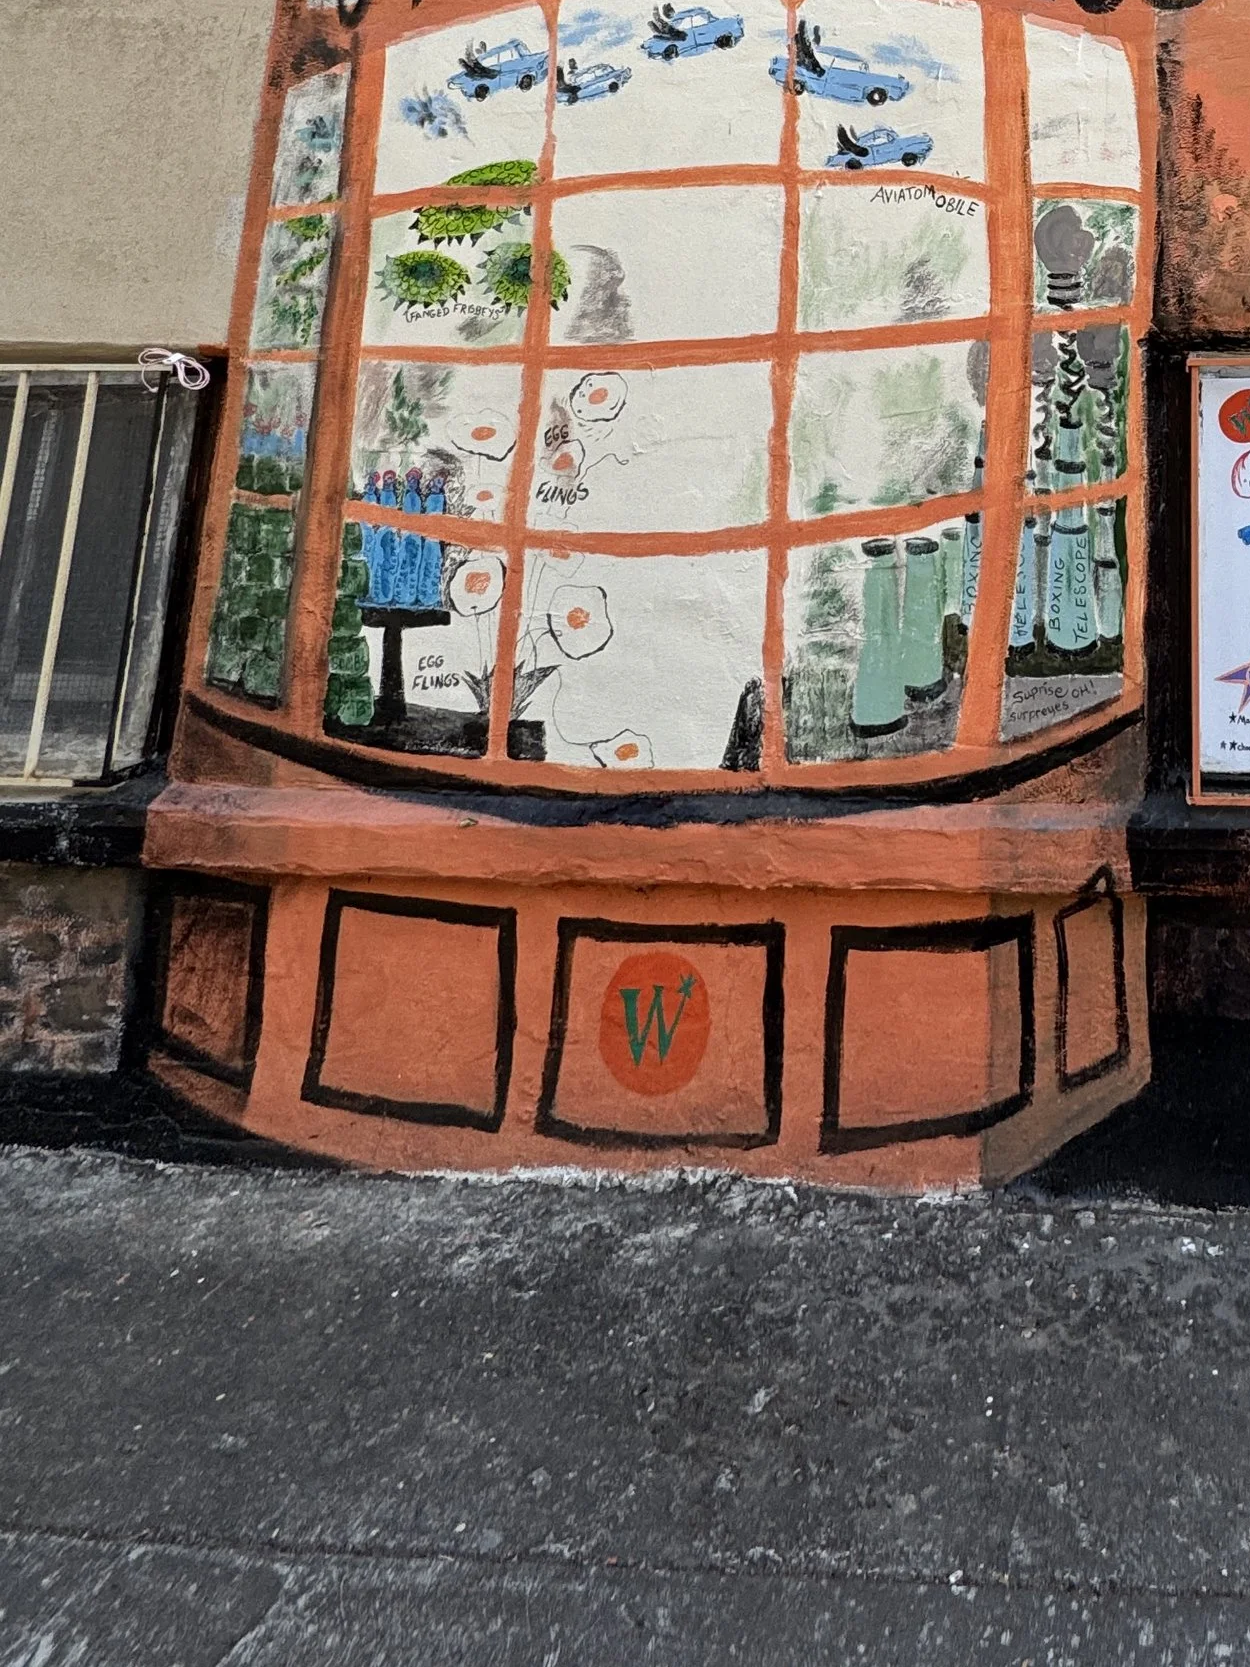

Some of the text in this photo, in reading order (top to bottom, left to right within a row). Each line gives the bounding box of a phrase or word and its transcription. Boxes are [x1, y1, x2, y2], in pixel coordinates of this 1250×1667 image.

[869, 184, 980, 218] AVIATOMOBILE
[543, 424, 570, 446] EGG
[535, 481, 590, 506] FLINGS
[1047, 556, 1066, 632] BOXING
[1071, 536, 1090, 645] TELESCOPE
[418, 655, 445, 672] EGG
[411, 672, 460, 691] FLINGS
[1011, 681, 1069, 706] Suprise
[618, 976, 692, 1069] W
